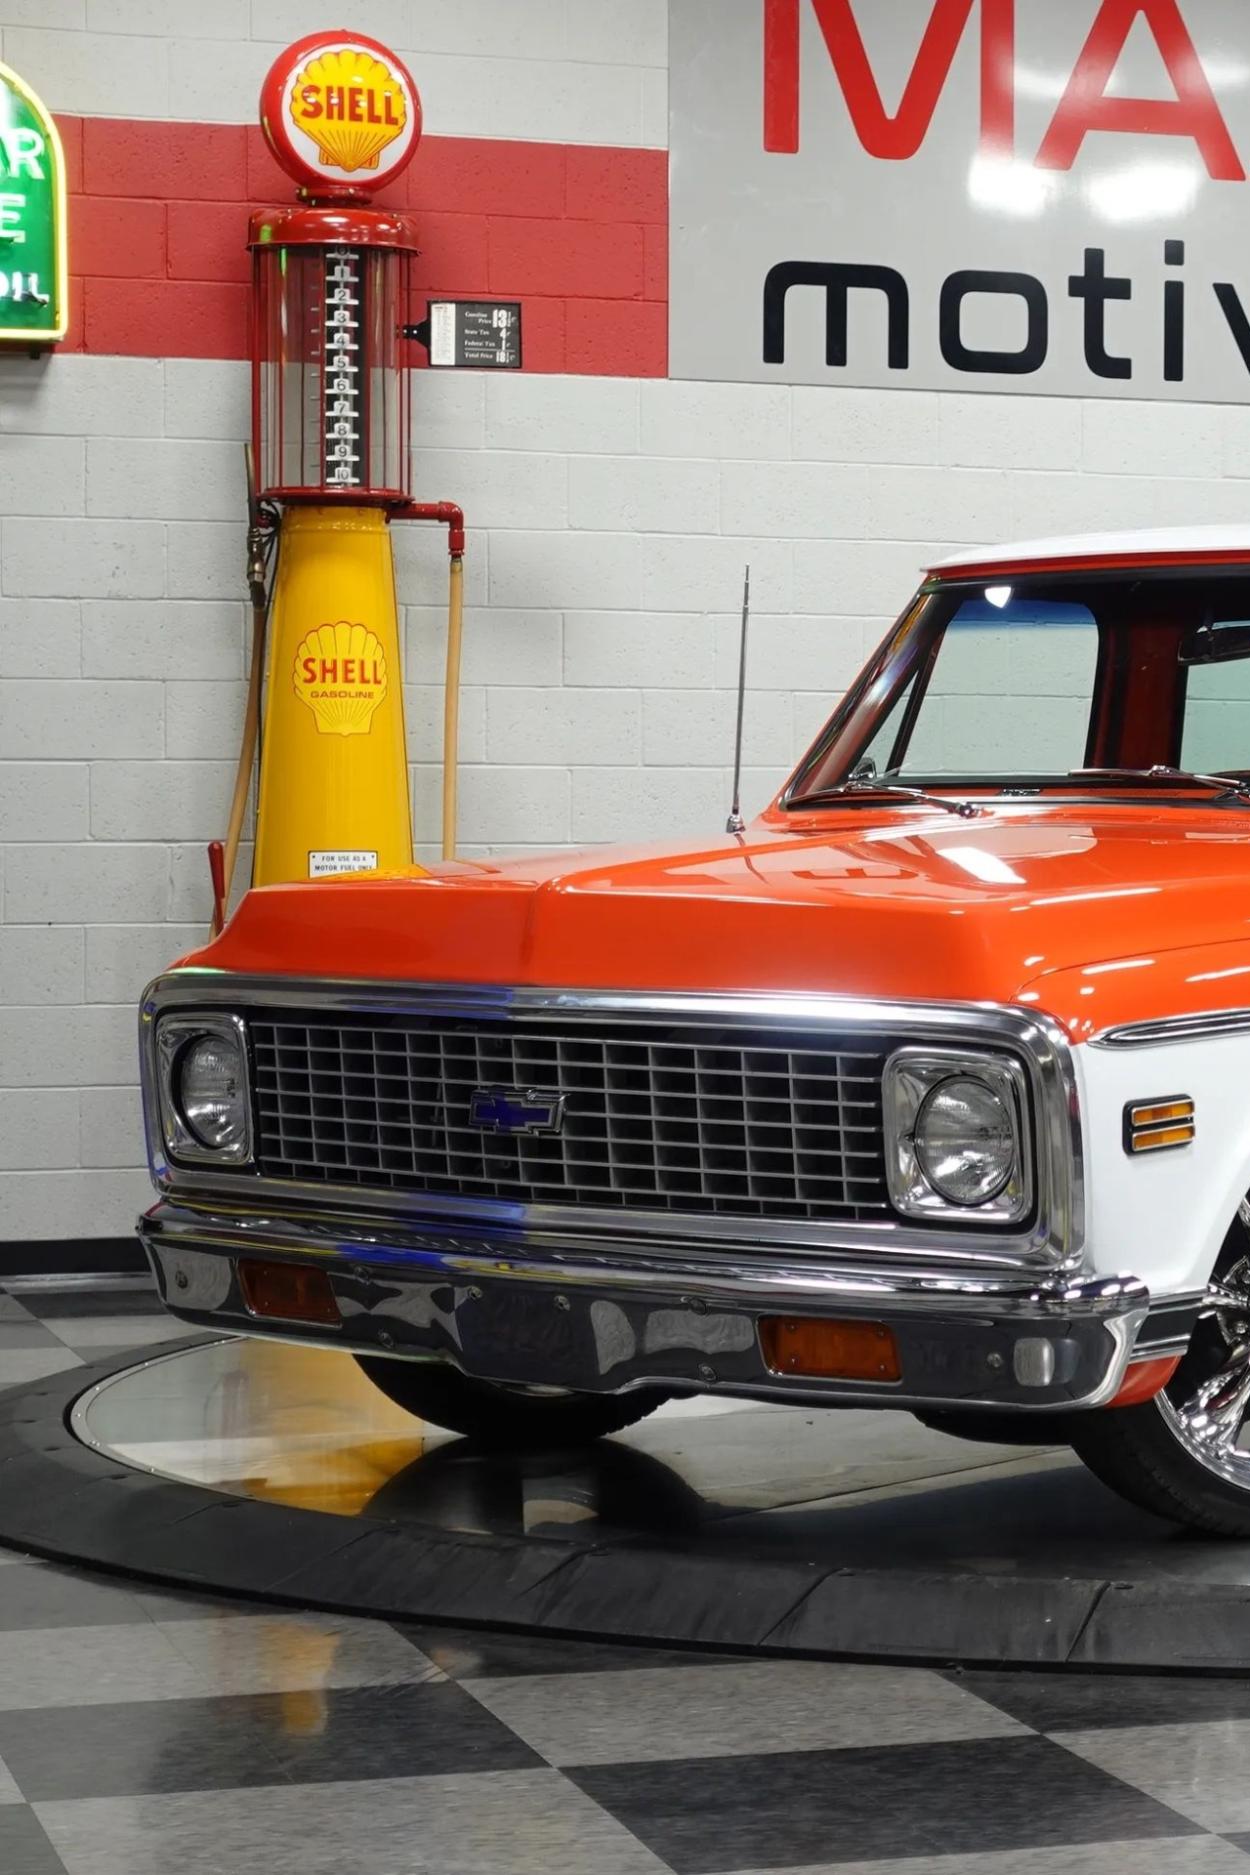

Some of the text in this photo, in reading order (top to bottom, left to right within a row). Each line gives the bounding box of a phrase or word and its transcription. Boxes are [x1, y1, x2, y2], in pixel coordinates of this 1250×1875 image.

[301, 85, 399, 126] SHELL
[303, 657, 382, 685] SHELL
[310, 690, 375, 699] GASOLINE
